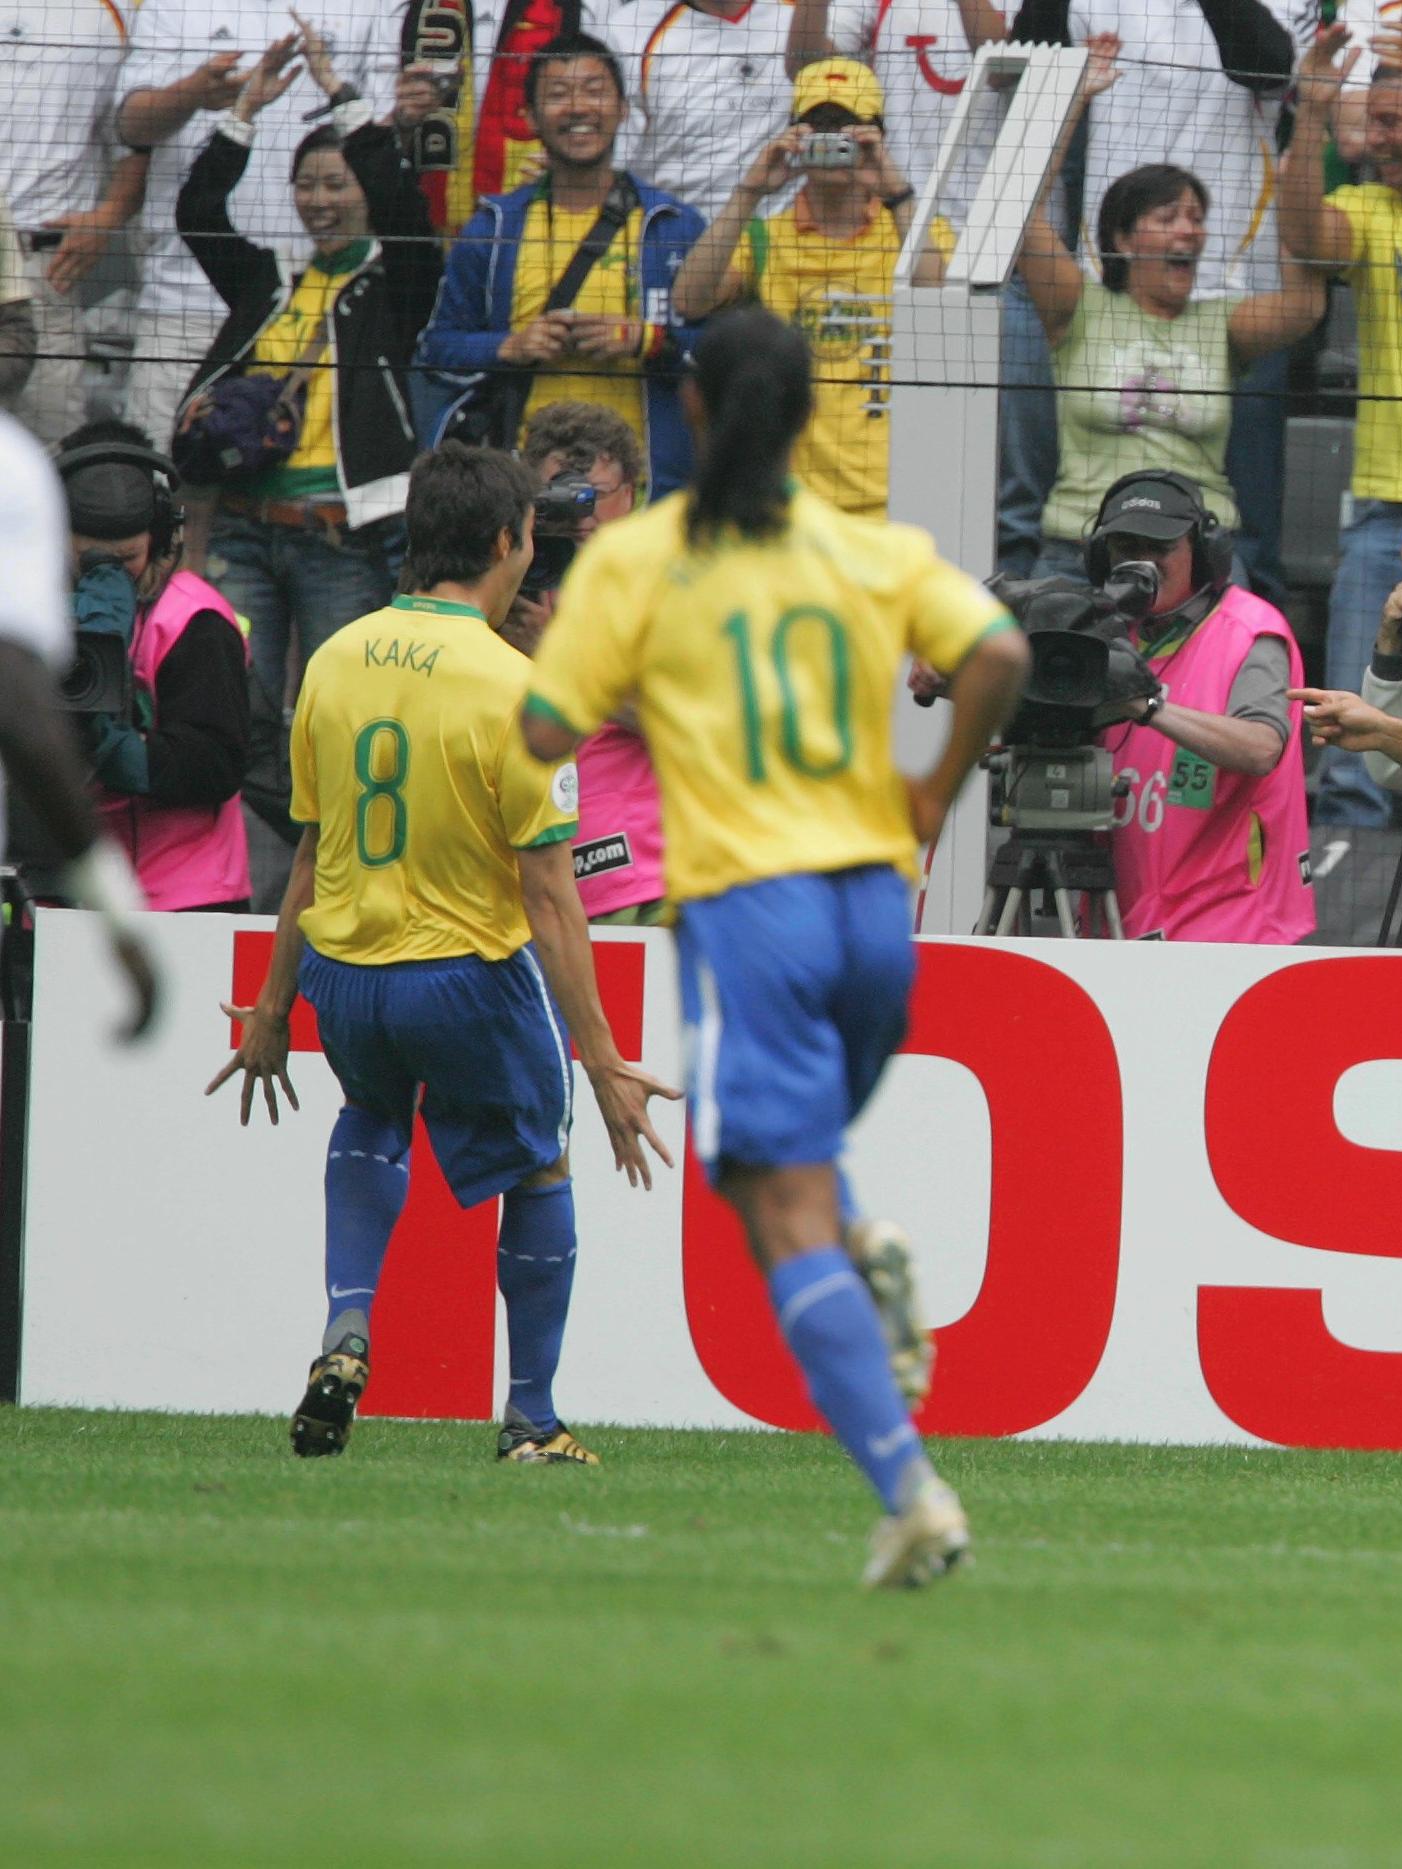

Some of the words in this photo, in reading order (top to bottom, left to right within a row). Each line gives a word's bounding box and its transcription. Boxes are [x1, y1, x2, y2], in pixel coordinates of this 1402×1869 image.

[721, 605, 854, 783] 10
[353, 716, 412, 870] 8
[1170, 761, 1209, 791] 55
